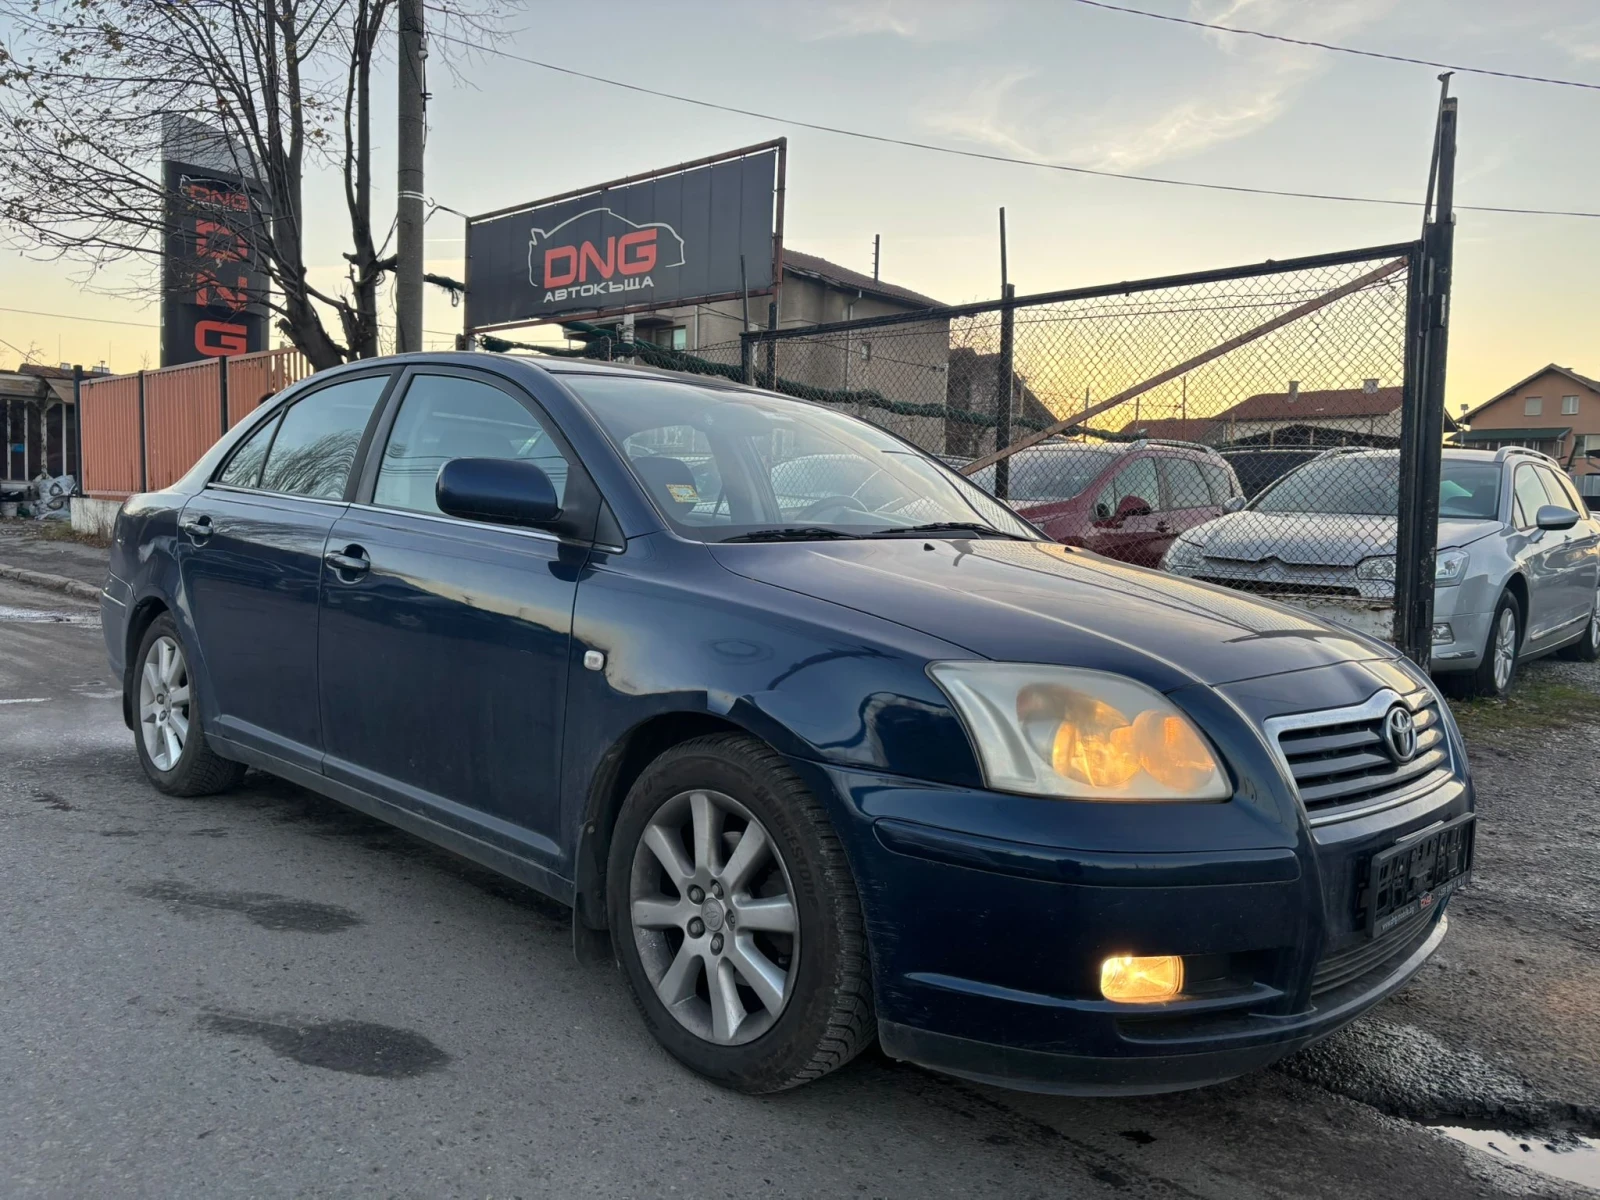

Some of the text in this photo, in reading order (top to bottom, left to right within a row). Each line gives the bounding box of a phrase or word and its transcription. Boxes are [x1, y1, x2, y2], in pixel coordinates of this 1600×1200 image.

[190, 184, 248, 211] DNG
[544, 228, 657, 289] DNG
[543, 276, 654, 303] АВТОКЪЩА
